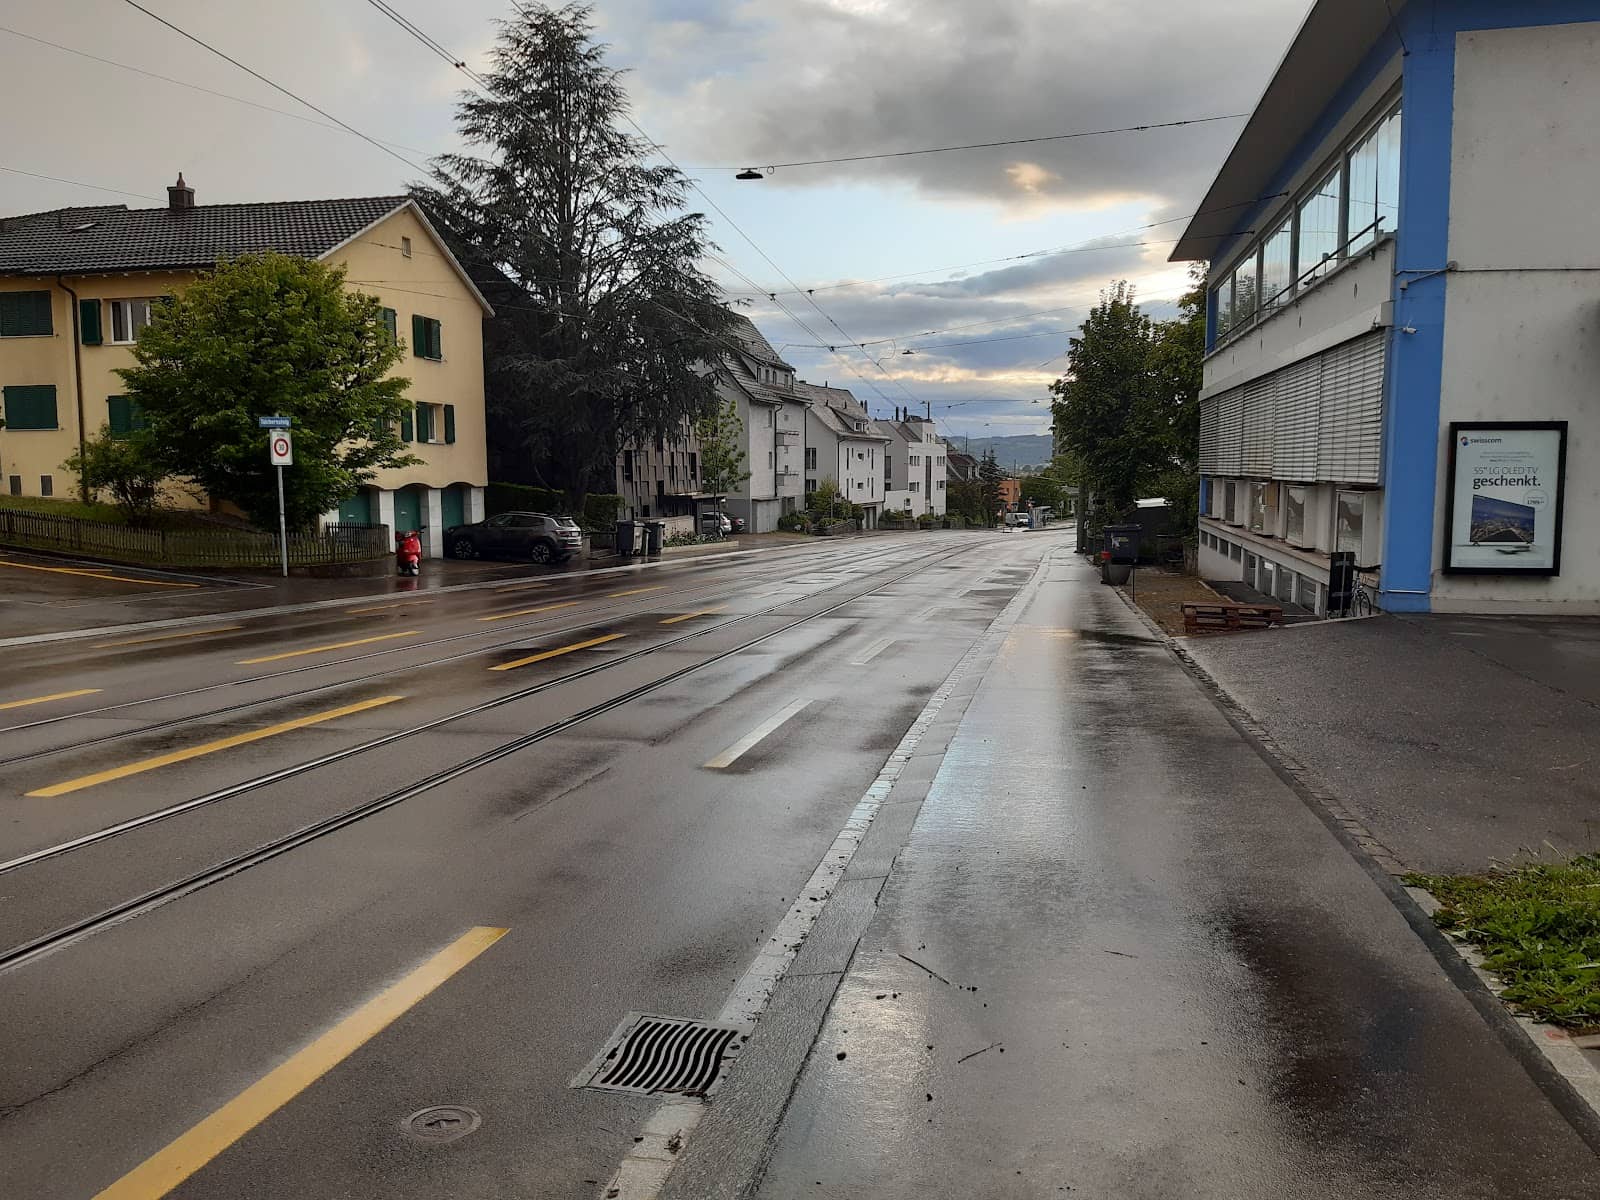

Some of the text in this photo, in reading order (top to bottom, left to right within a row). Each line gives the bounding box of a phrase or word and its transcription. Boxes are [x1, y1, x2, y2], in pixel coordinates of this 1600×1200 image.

[1489, 466, 1500, 475] LG
[1501, 466, 1525, 475] OLED
[1526, 466, 1538, 475] TV
[1472, 474, 1541, 490] geschenkt.
